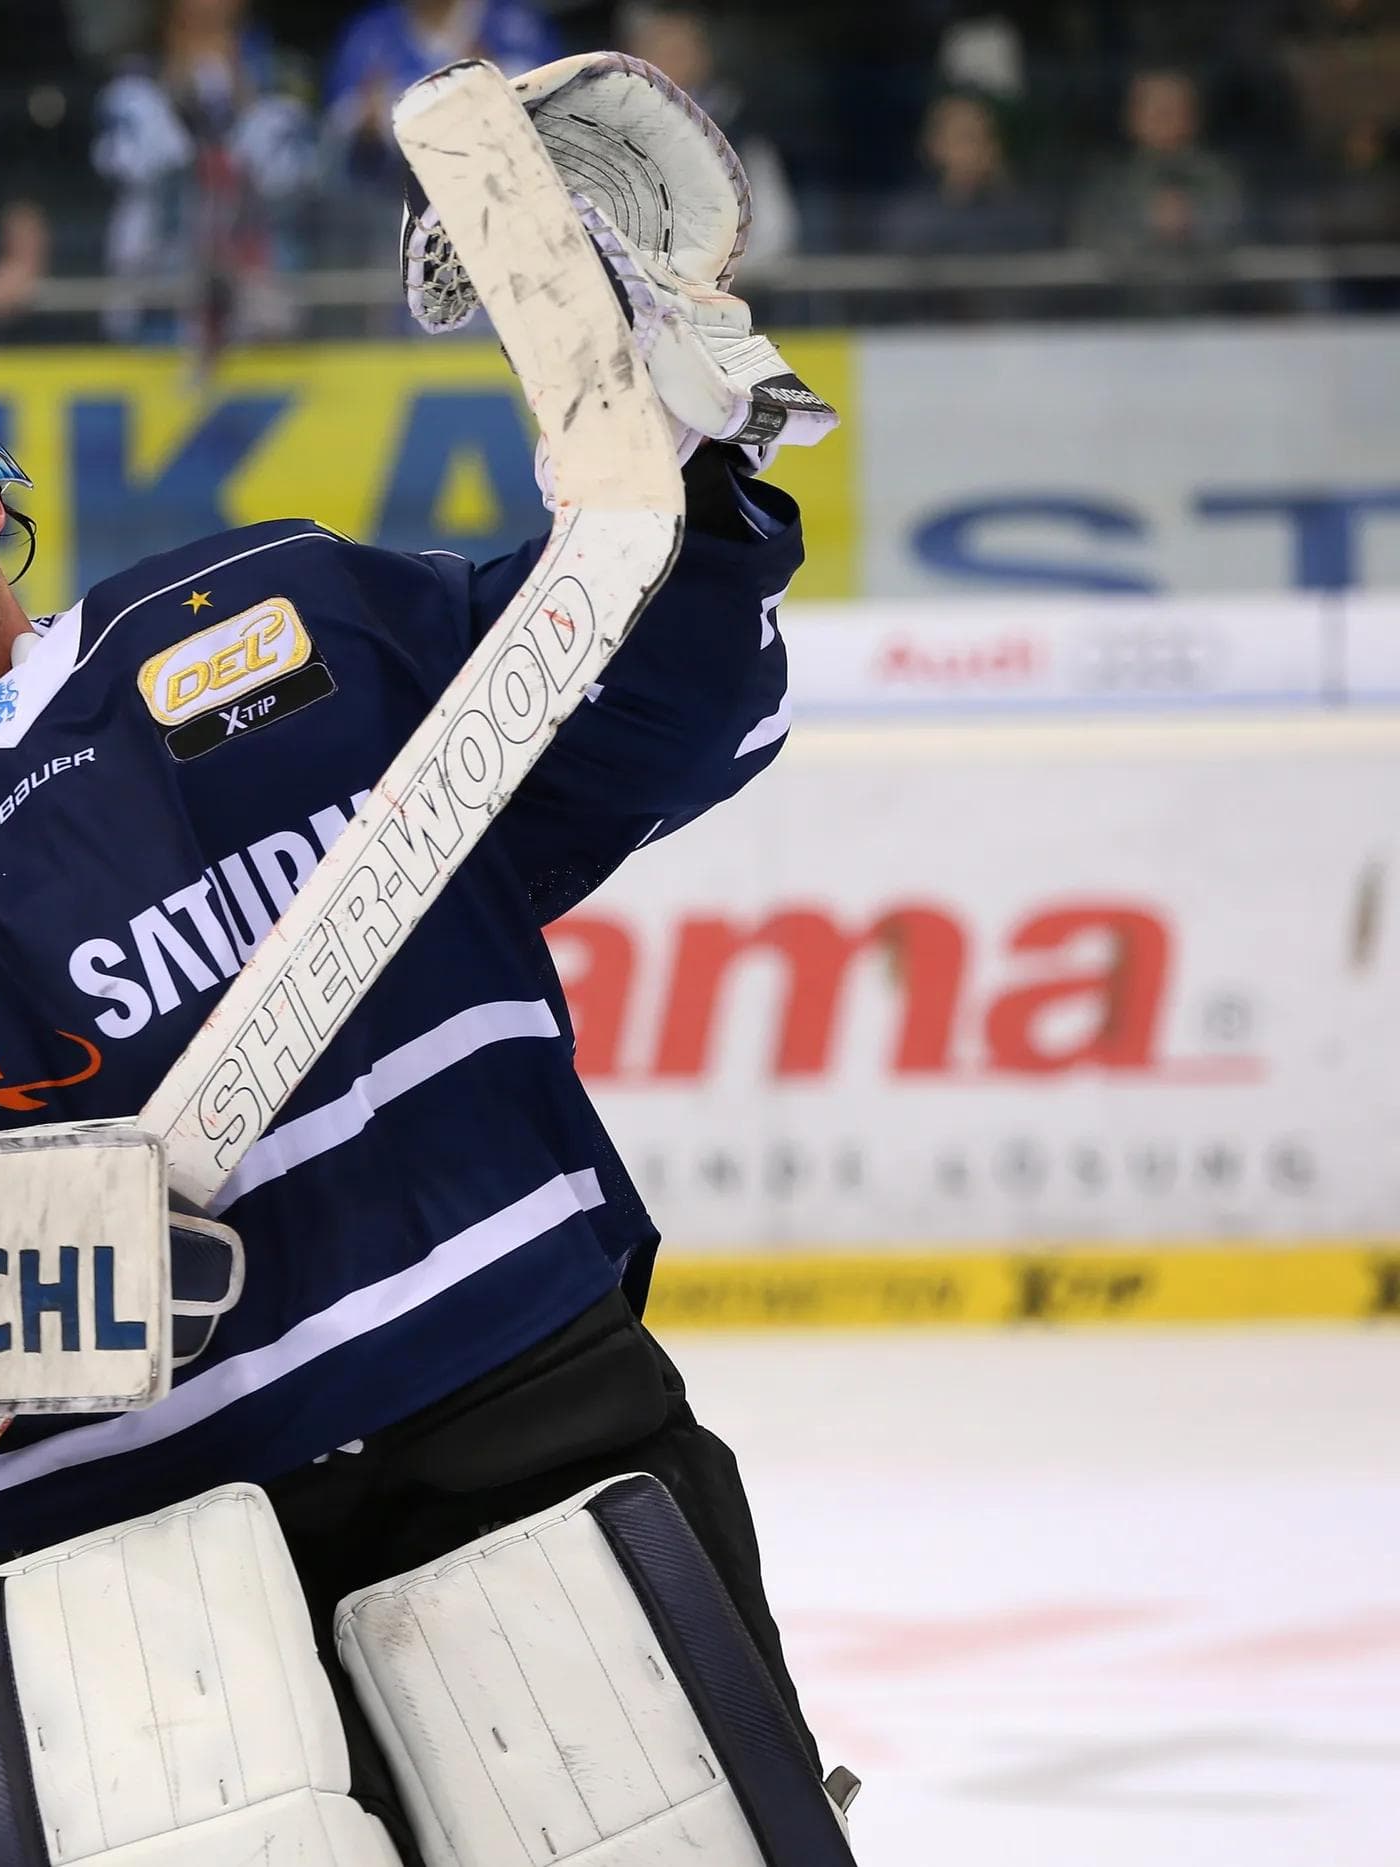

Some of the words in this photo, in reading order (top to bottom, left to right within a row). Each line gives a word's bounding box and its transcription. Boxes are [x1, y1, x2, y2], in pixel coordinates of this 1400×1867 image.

[166, 622, 281, 713] DEL
[882, 636, 1038, 682] Audi
[200, 575, 596, 1169] SHER-WOOD
